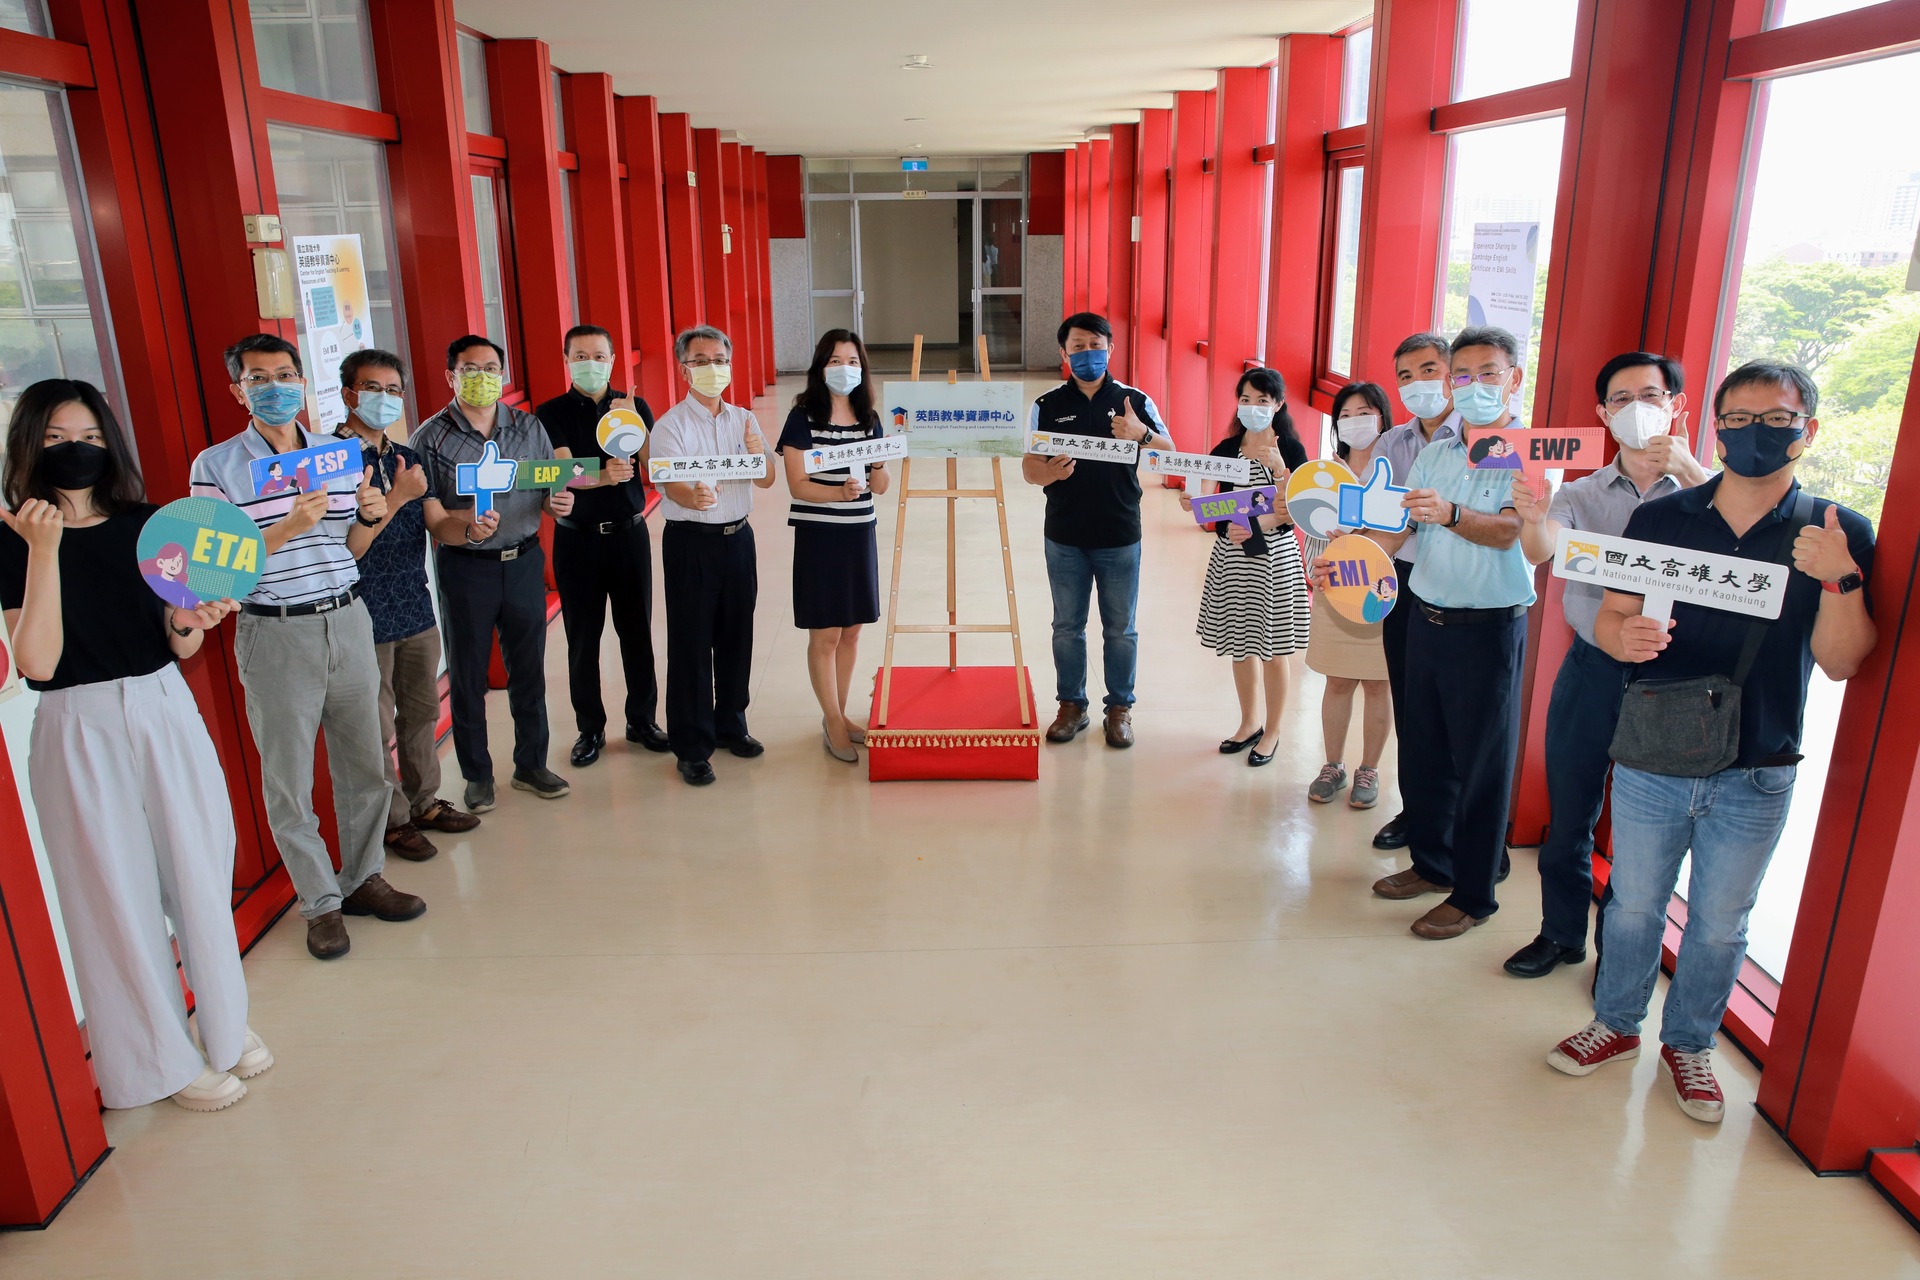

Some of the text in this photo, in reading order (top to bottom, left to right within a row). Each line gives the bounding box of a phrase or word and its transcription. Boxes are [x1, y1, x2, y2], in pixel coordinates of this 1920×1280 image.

[1496, 243, 1510, 251] Sharing
[1472, 254, 1492, 262] Cambridge
[916, 410, 1014, 422] 英語教學資源中心
[828, 442, 900, 460] 英語教學資源中心
[1052, 438, 1136, 454] 國立高雄大學
[1530, 438, 1581, 461] EWP
[314, 449, 348, 475] ESP
[673, 456, 763, 470] 國立高雄大學
[1108, 453, 1133, 461] Kaohsiung
[1164, 456, 1243, 473] 英語教學資源中心
[534, 466, 560, 483] EAP
[1201, 499, 1238, 518] ESAP
[192, 527, 258, 573] ETA
[1329, 560, 1369, 587] EMI
[1605, 550, 1772, 593] 國立高雄大學
[1602, 568, 1766, 608] National University of Kaohsiung
